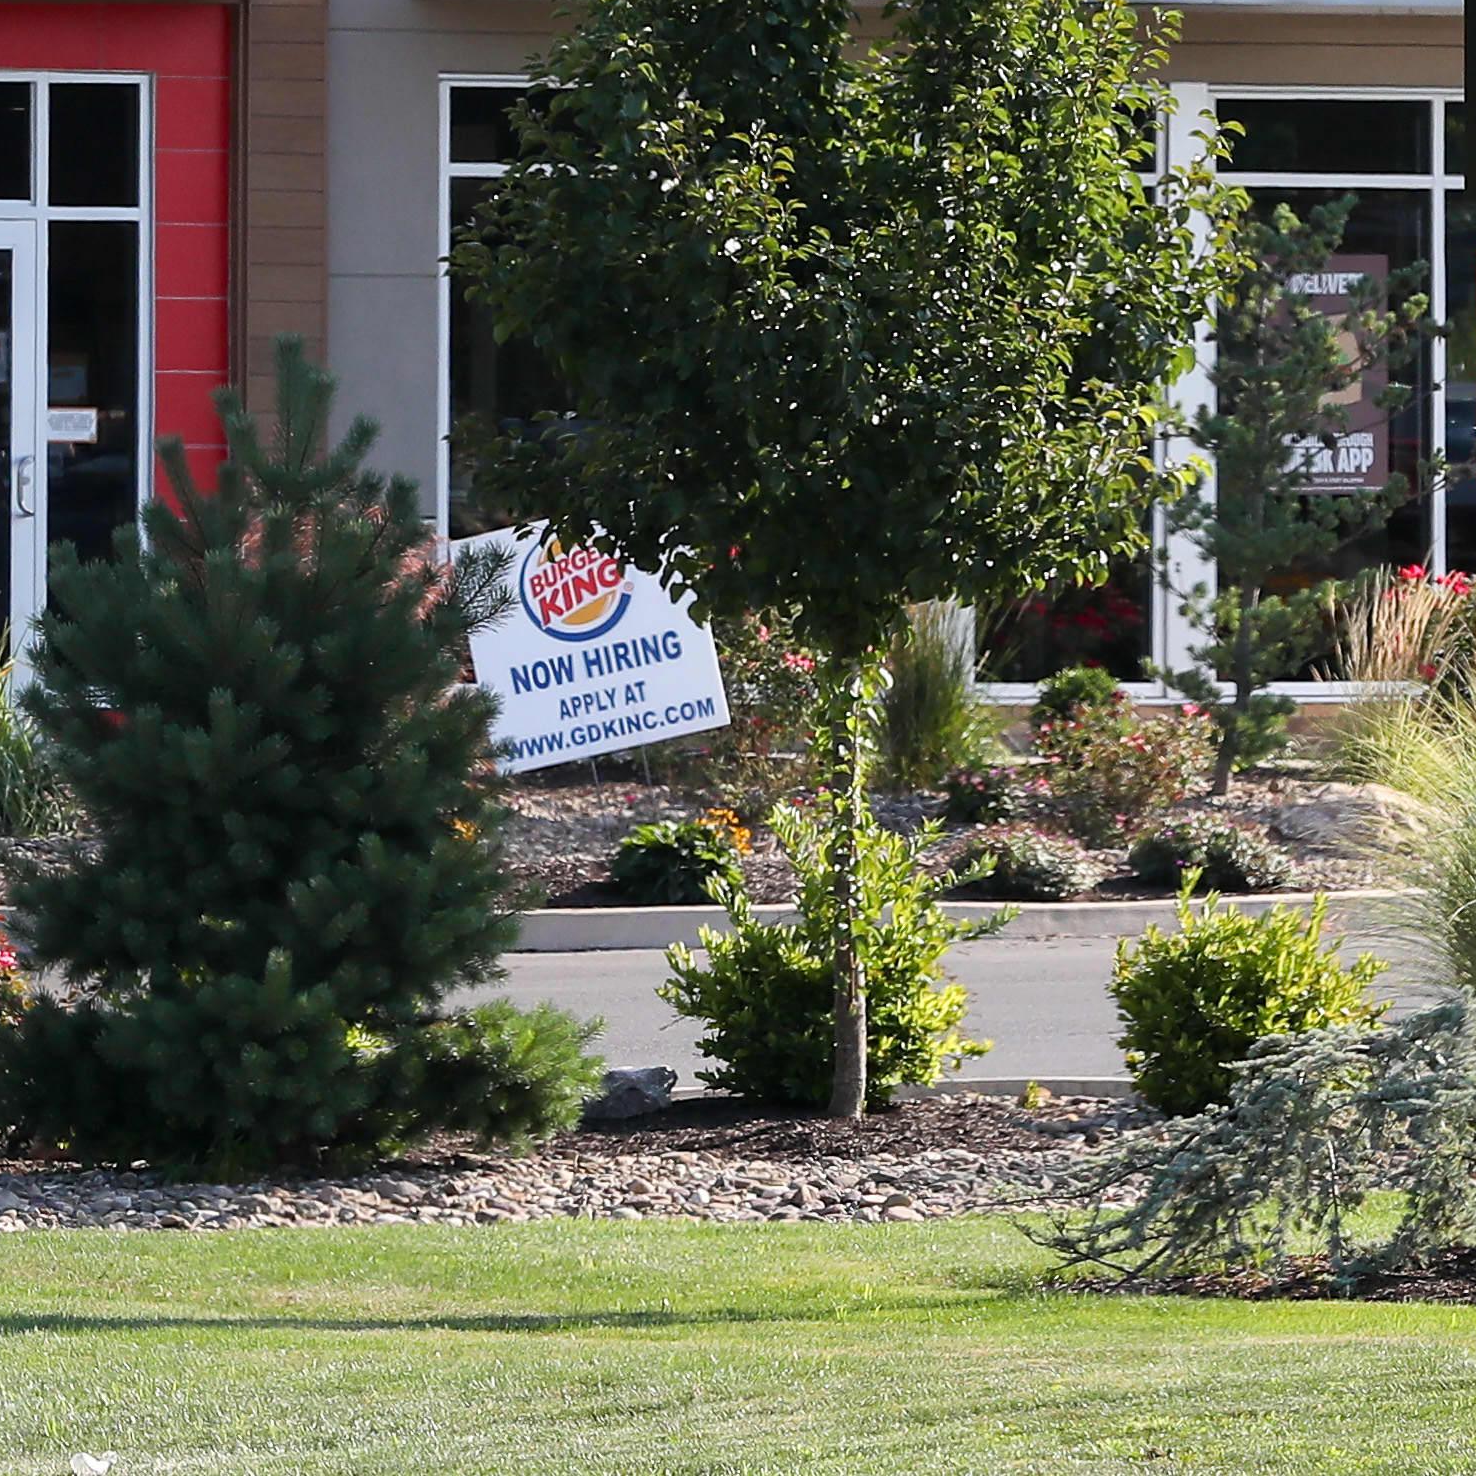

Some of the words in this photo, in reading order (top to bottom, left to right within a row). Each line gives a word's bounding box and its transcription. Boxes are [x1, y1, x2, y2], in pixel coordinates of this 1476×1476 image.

[1337, 447, 1375, 473] APP
[529, 545, 604, 598] BURGE
[539, 558, 621, 626] KING
[510, 653, 575, 695] NOW
[582, 630, 683, 678] HIRING
[559, 687, 617, 720] APPLY
[625, 680, 647, 706] AT
